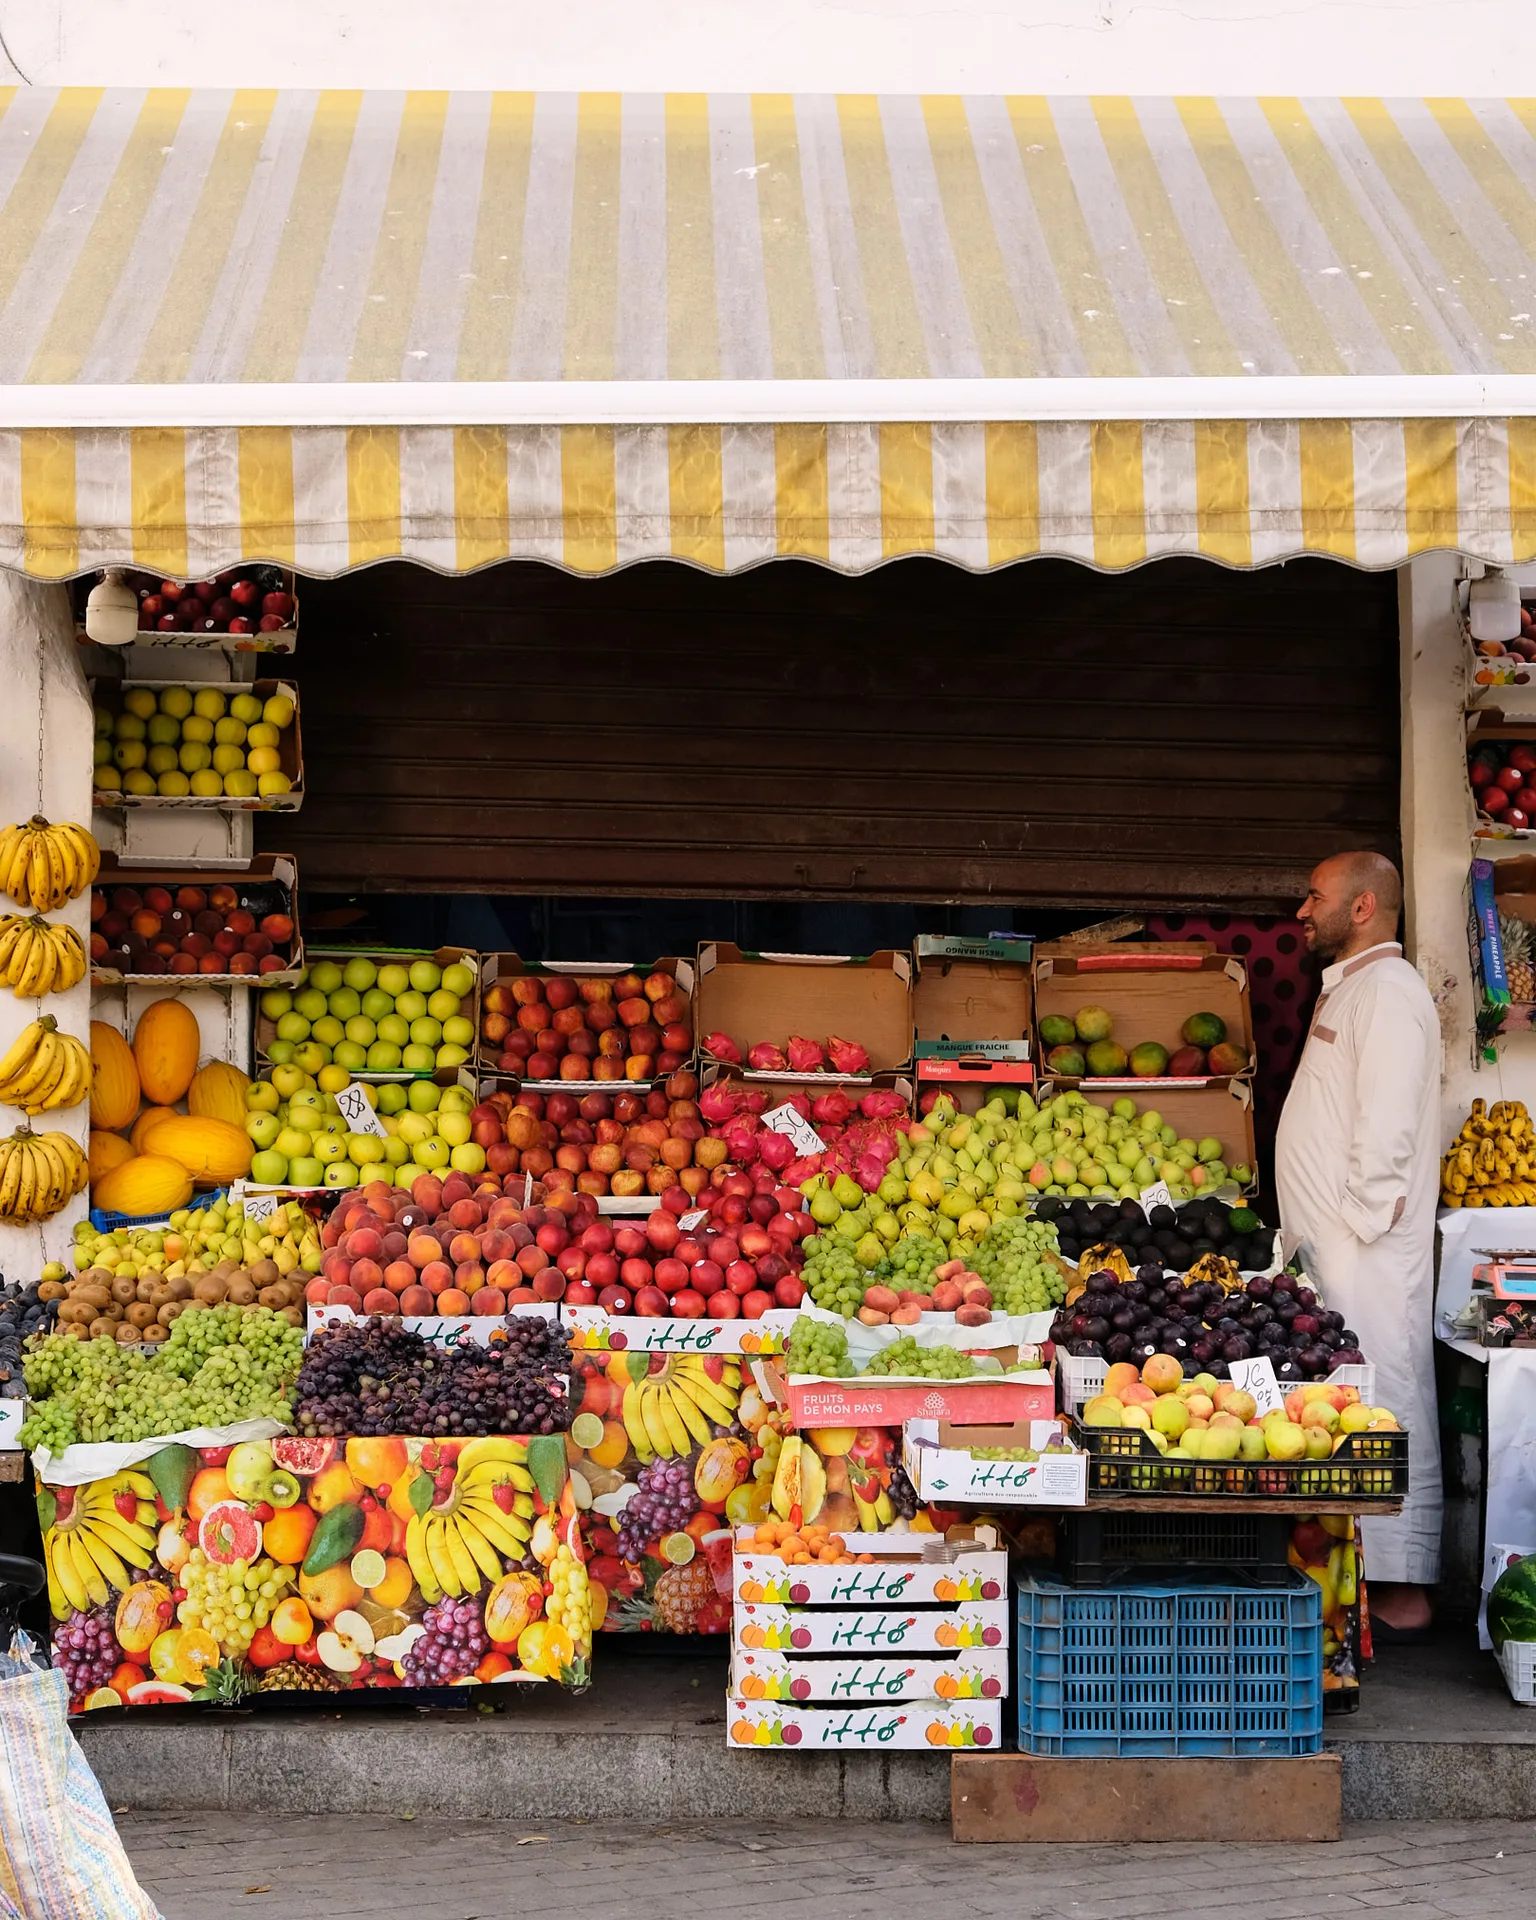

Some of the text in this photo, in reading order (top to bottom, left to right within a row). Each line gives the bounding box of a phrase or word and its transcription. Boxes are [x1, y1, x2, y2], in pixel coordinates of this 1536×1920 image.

[1486, 908, 1496, 935] SWEET
[1491, 936, 1502, 979] PINEAPPLE
[945, 946, 1005, 958] FRESH MANGO
[936, 1043, 1010, 1052] MANGUE FRAICHE
[803, 1394, 844, 1405] FRUITS
[803, 1403, 883, 1415] DE MON PAYS
[916, 1407, 951, 1417] Shajara
